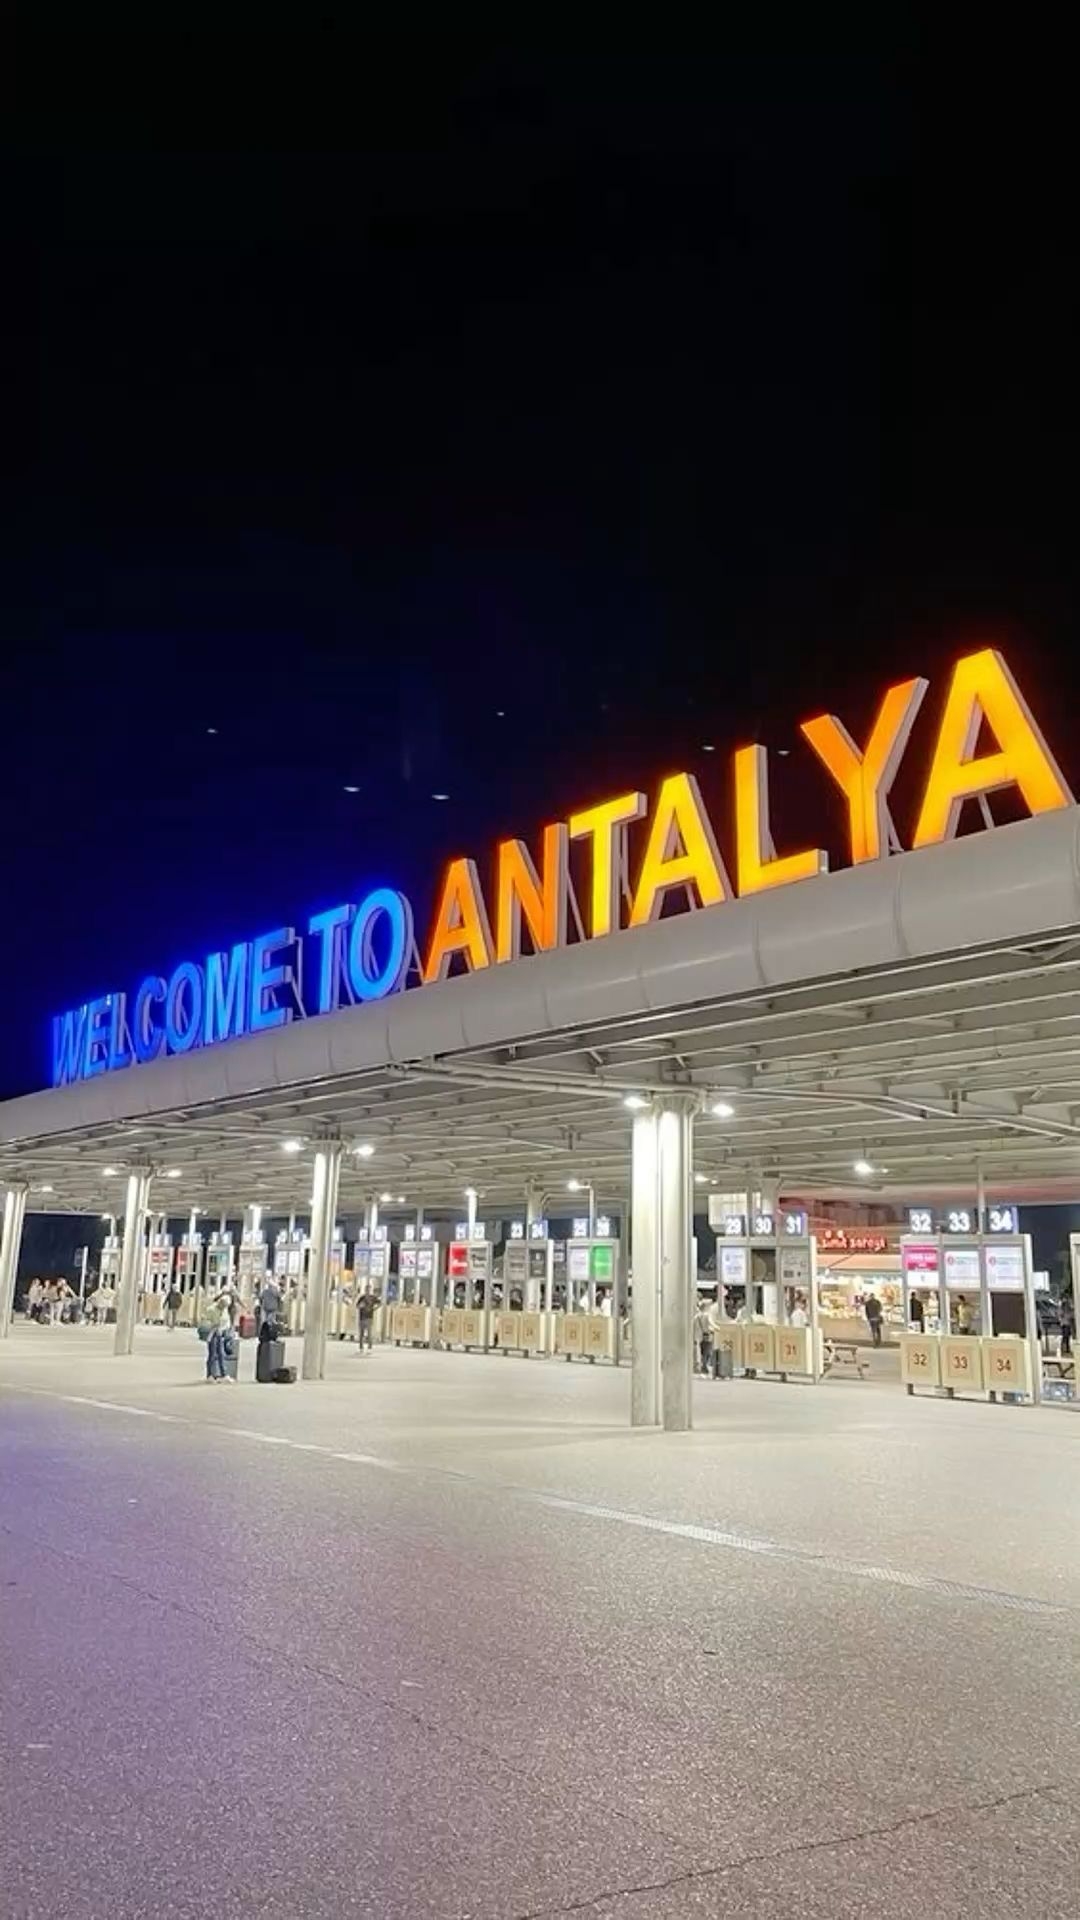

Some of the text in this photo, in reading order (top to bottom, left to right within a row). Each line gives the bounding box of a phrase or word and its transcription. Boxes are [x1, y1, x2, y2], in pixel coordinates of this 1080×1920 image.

[52, 649, 1075, 1088] WELCOME TO ANTALYA
[726, 1217, 742, 1237] 29
[755, 1216, 772, 1235] 30
[786, 1215, 802, 1234] 31
[911, 1212, 931, 1232] 32
[949, 1212, 970, 1232] 33
[989, 1211, 1012, 1232] 34
[913, 1353, 927, 1366] 32
[953, 1355, 968, 1370] 33
[996, 1358, 1012, 1372] 34
